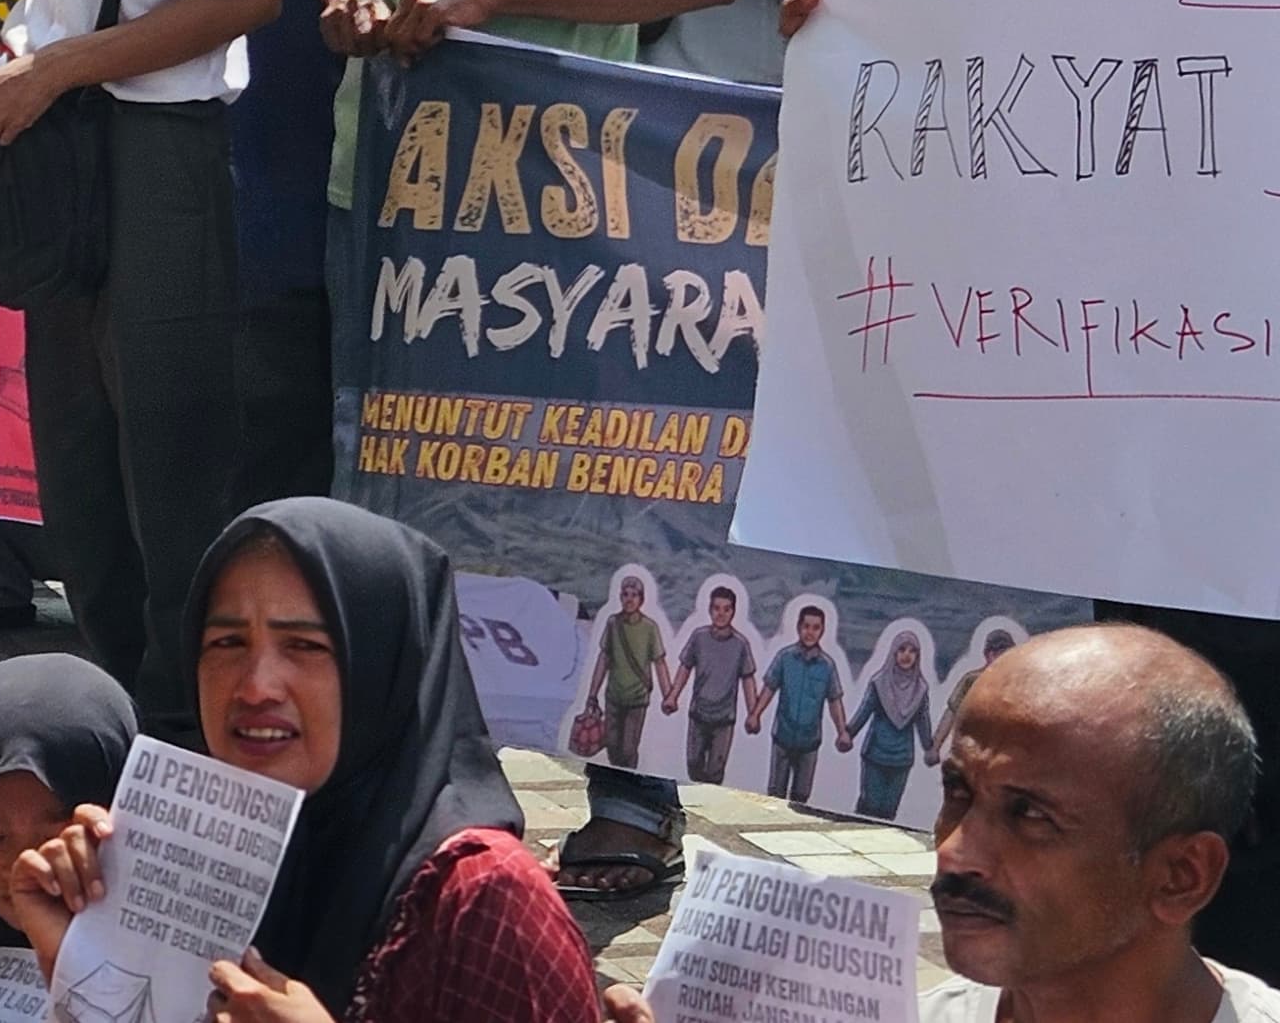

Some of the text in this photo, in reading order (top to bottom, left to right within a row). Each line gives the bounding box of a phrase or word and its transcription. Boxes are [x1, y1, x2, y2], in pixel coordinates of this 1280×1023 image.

[848, 54, 1232, 181] RAKYAT
[378, 101, 639, 239] AKSI
[370, 255, 768, 374] MASYARA
[360, 392, 752, 460] MENUNTUT KEADILAN D
[358, 436, 724, 504] HAK KORBAN BENCARA
[133, 751, 159, 784] DI
[118, 788, 192, 832] JANGAN
[193, 812, 235, 848] LAGI
[125, 828, 163, 855] KAMI
[162, 842, 207, 874] SUDAH
[127, 884, 210, 932] KEHILANGAN
[132, 859, 180, 894] RUMAH,
[184, 878, 237, 915] JANGAN
[692, 865, 896, 949] DI PENGUNGSIAN,
[119, 908, 171, 942] TEMPAT
[672, 907, 903, 986] JANGAN LAGI DIGUSUR!
[672, 950, 880, 1021] KAMI SUDAH KEHILANGAN
[678, 984, 737, 1019] RUMAH,
